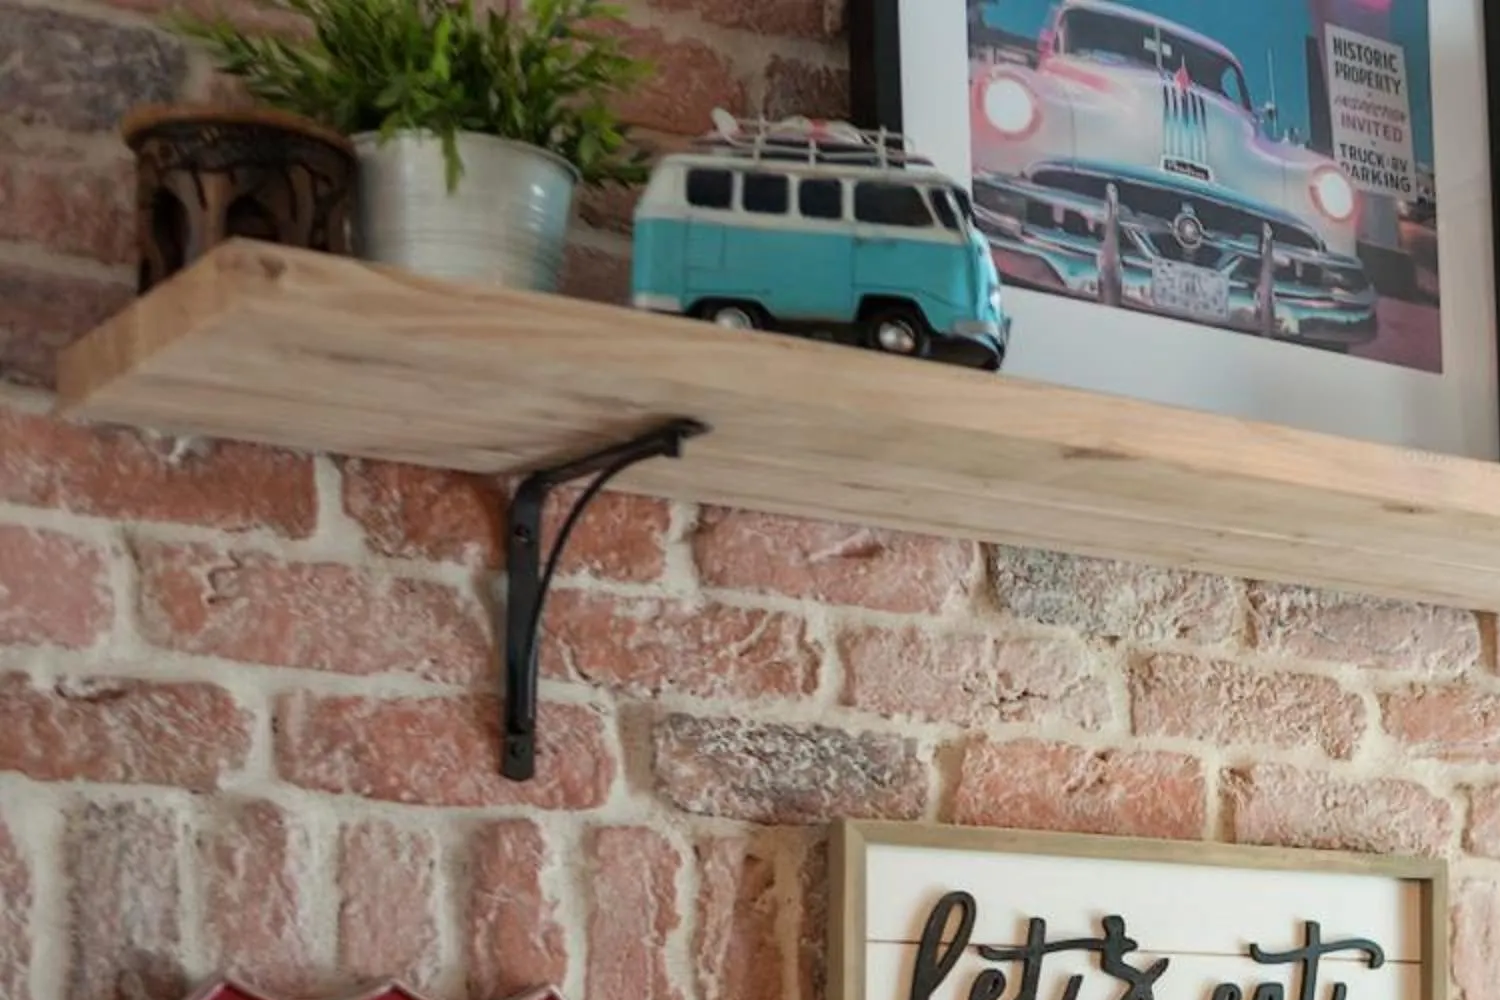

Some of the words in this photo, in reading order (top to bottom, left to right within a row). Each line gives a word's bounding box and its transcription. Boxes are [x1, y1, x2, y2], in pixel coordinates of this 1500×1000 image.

[1333, 36, 1399, 73] HISTORIC
[1334, 61, 1401, 95] PROPERTY
[1340, 111, 1403, 143] INVITED
